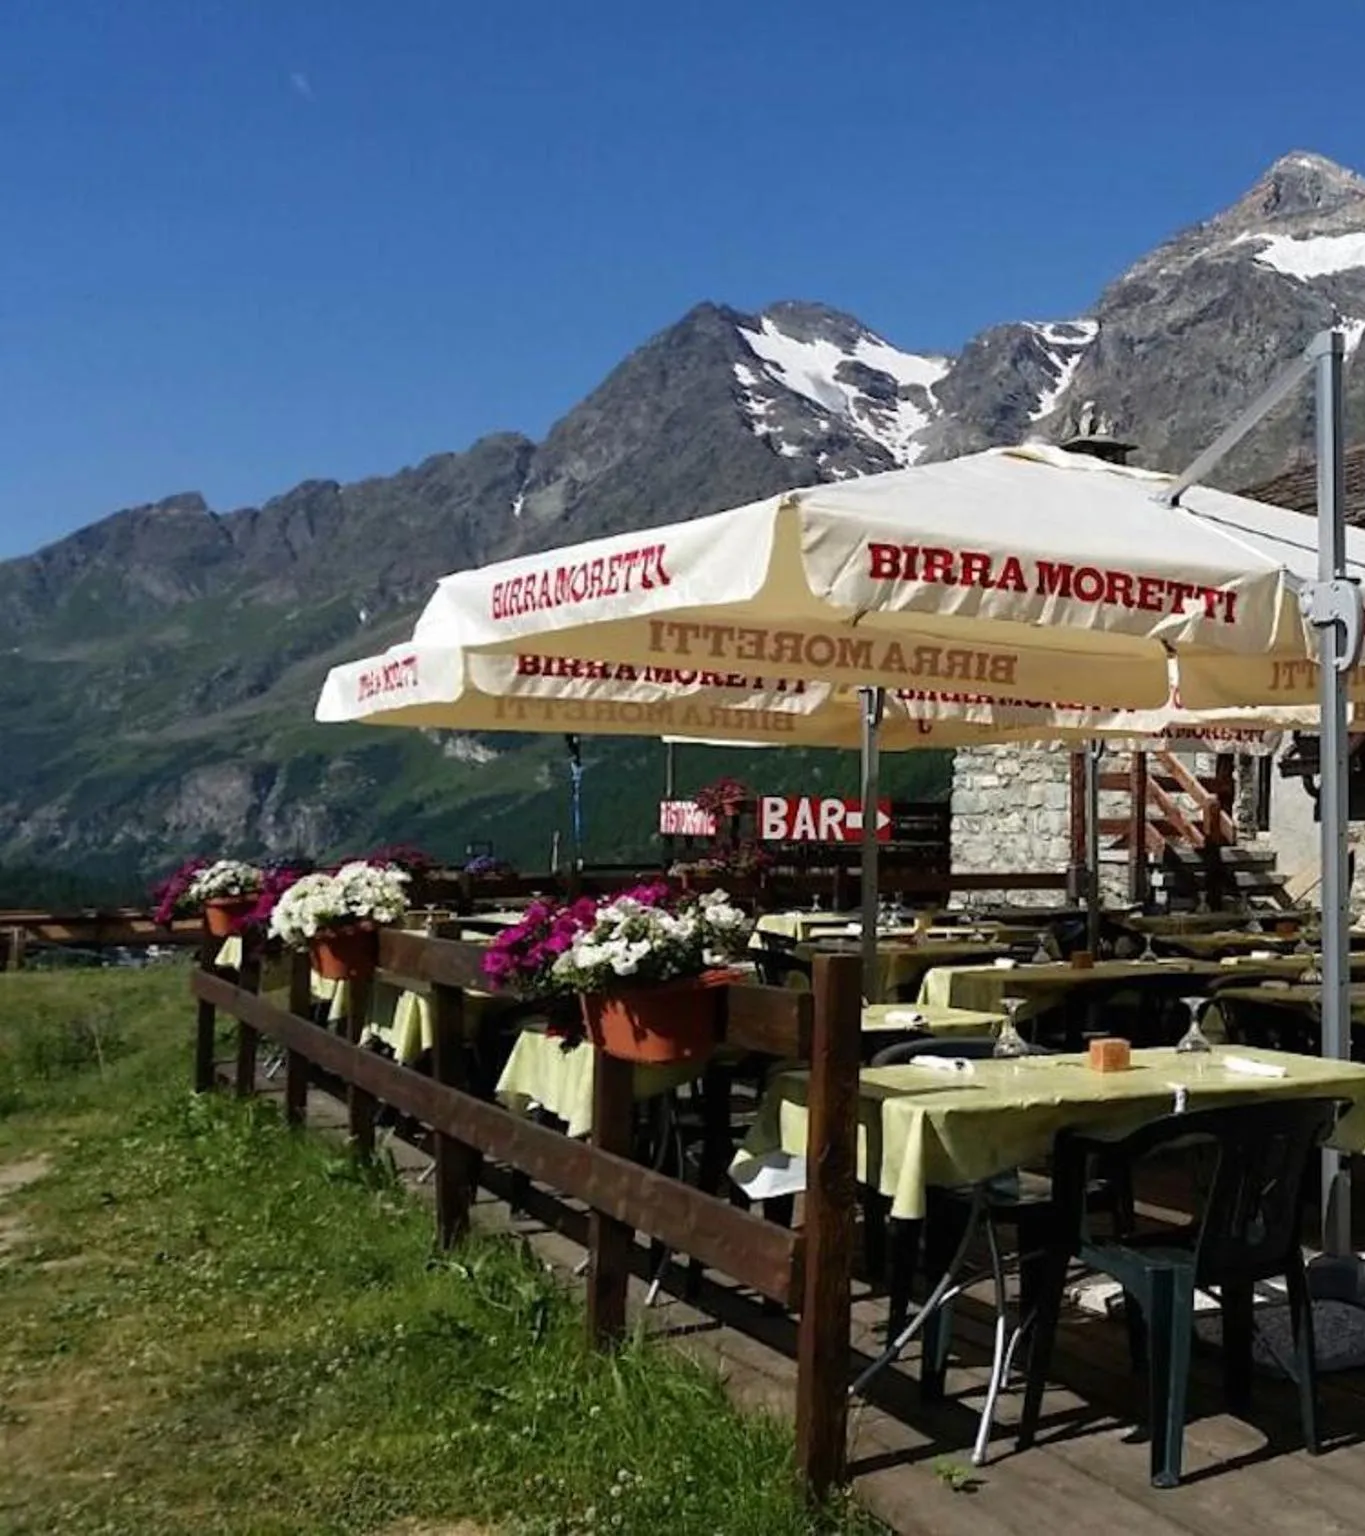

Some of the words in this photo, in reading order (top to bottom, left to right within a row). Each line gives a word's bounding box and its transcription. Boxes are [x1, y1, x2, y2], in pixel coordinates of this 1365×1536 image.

[492, 570, 551, 620] BIRRA
[553, 543, 671, 605] MORETTI
[867, 542, 1028, 593] BIRRA
[1034, 561, 1239, 624] MORETTI
[762, 797, 846, 840] BAR
